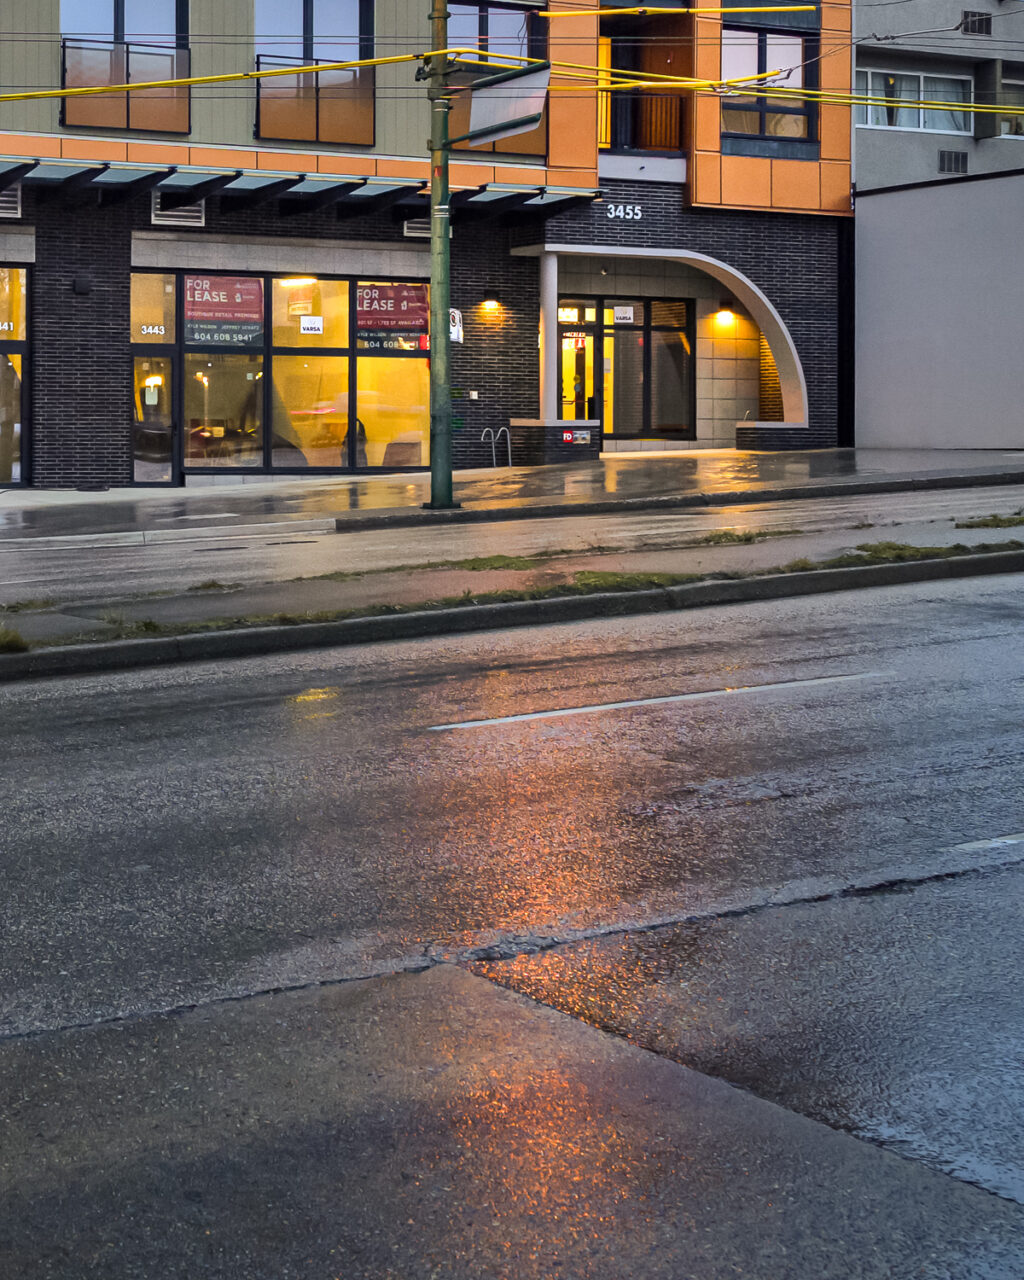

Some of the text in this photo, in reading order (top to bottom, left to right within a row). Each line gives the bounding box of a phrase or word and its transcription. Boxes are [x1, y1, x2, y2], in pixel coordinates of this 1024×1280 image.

[606, 204, 642, 220] 3455
[187, 279, 210, 290] FOR
[187, 291, 228, 302] LEASE
[357, 289, 379, 299] FOR
[356, 300, 395, 311] LEASE
[141, 325, 166, 335] 3443
[214, 333, 231, 341] 608
[563, 433, 573, 441] FD
